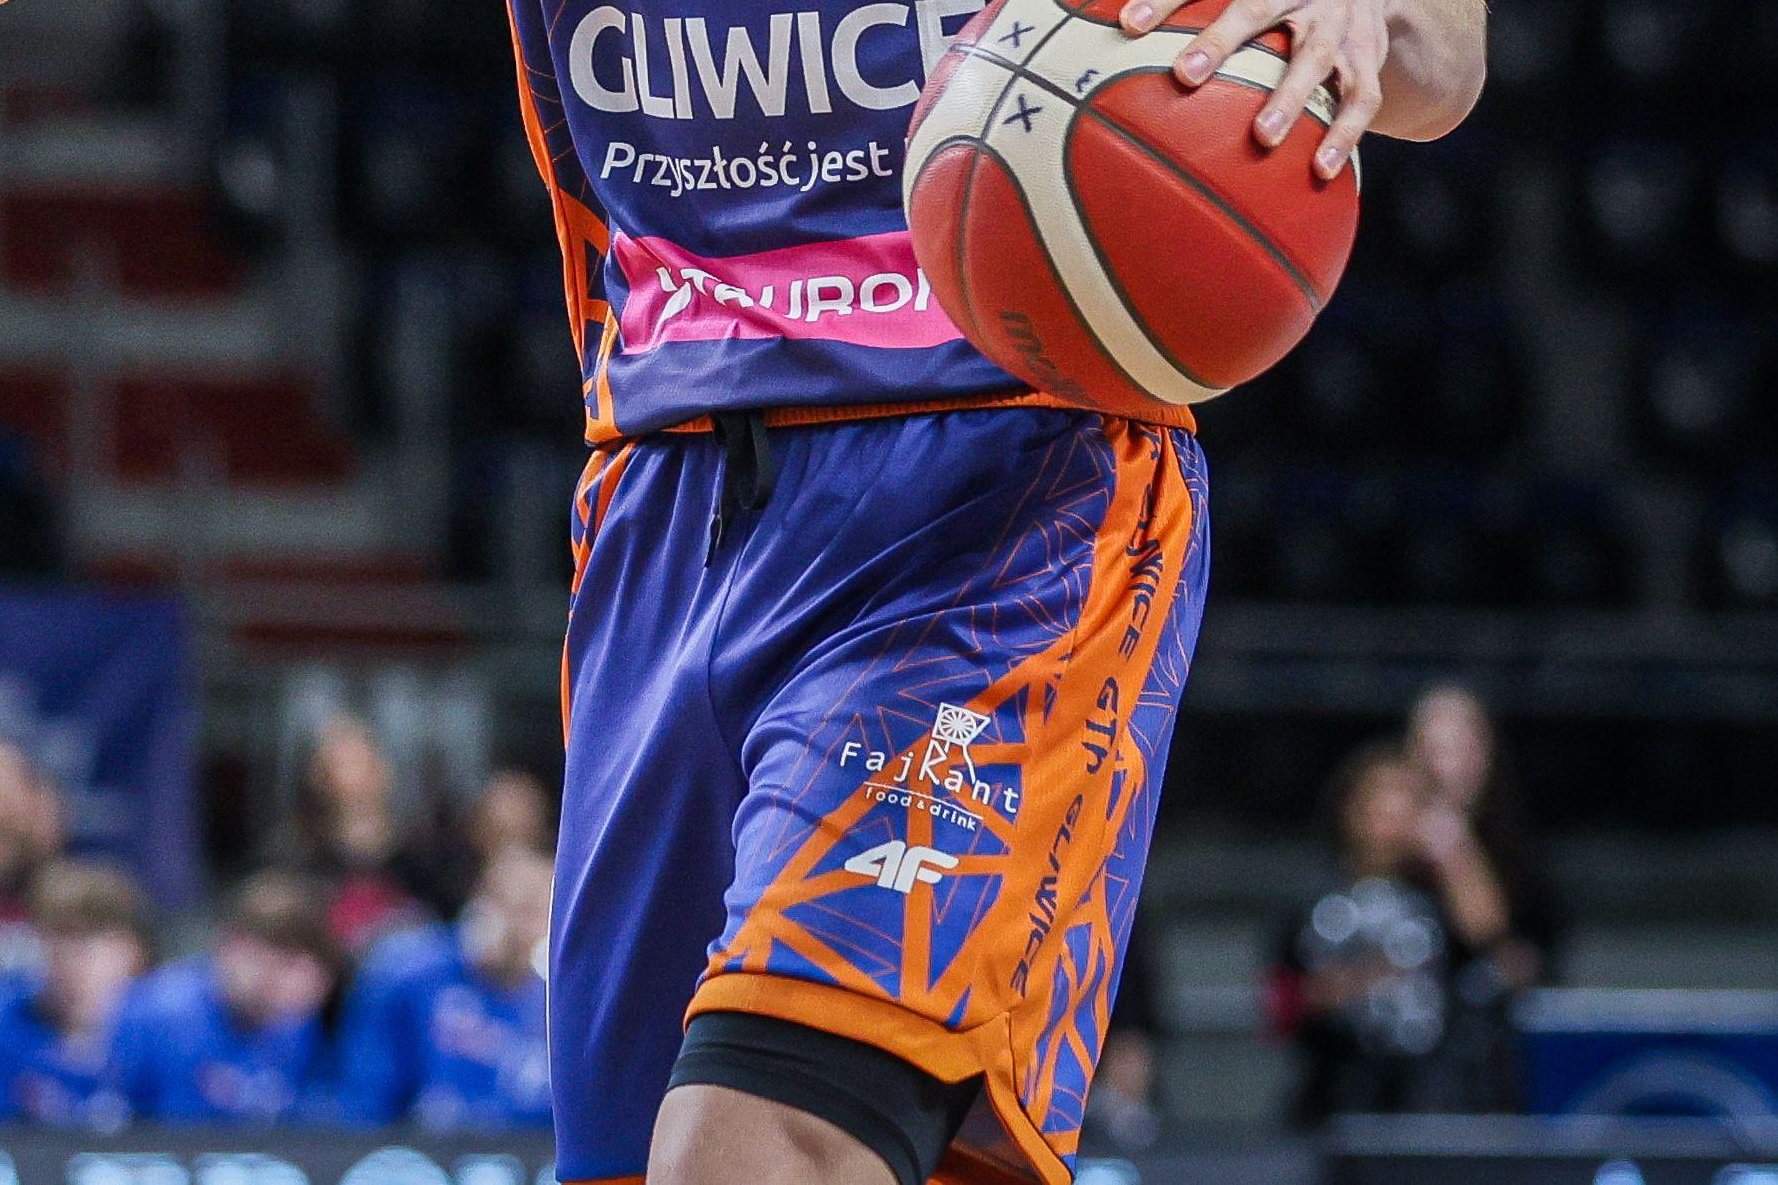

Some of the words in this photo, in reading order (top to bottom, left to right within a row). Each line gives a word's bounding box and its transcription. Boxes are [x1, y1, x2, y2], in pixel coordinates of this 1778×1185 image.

[599, 140, 800, 198] Przyszłość
[800, 140, 894, 192] jest
[865, 787, 913, 808] food
[916, 800, 926, 811] &
[929, 804, 977, 832] drink
[844, 839, 960, 895] 4F
